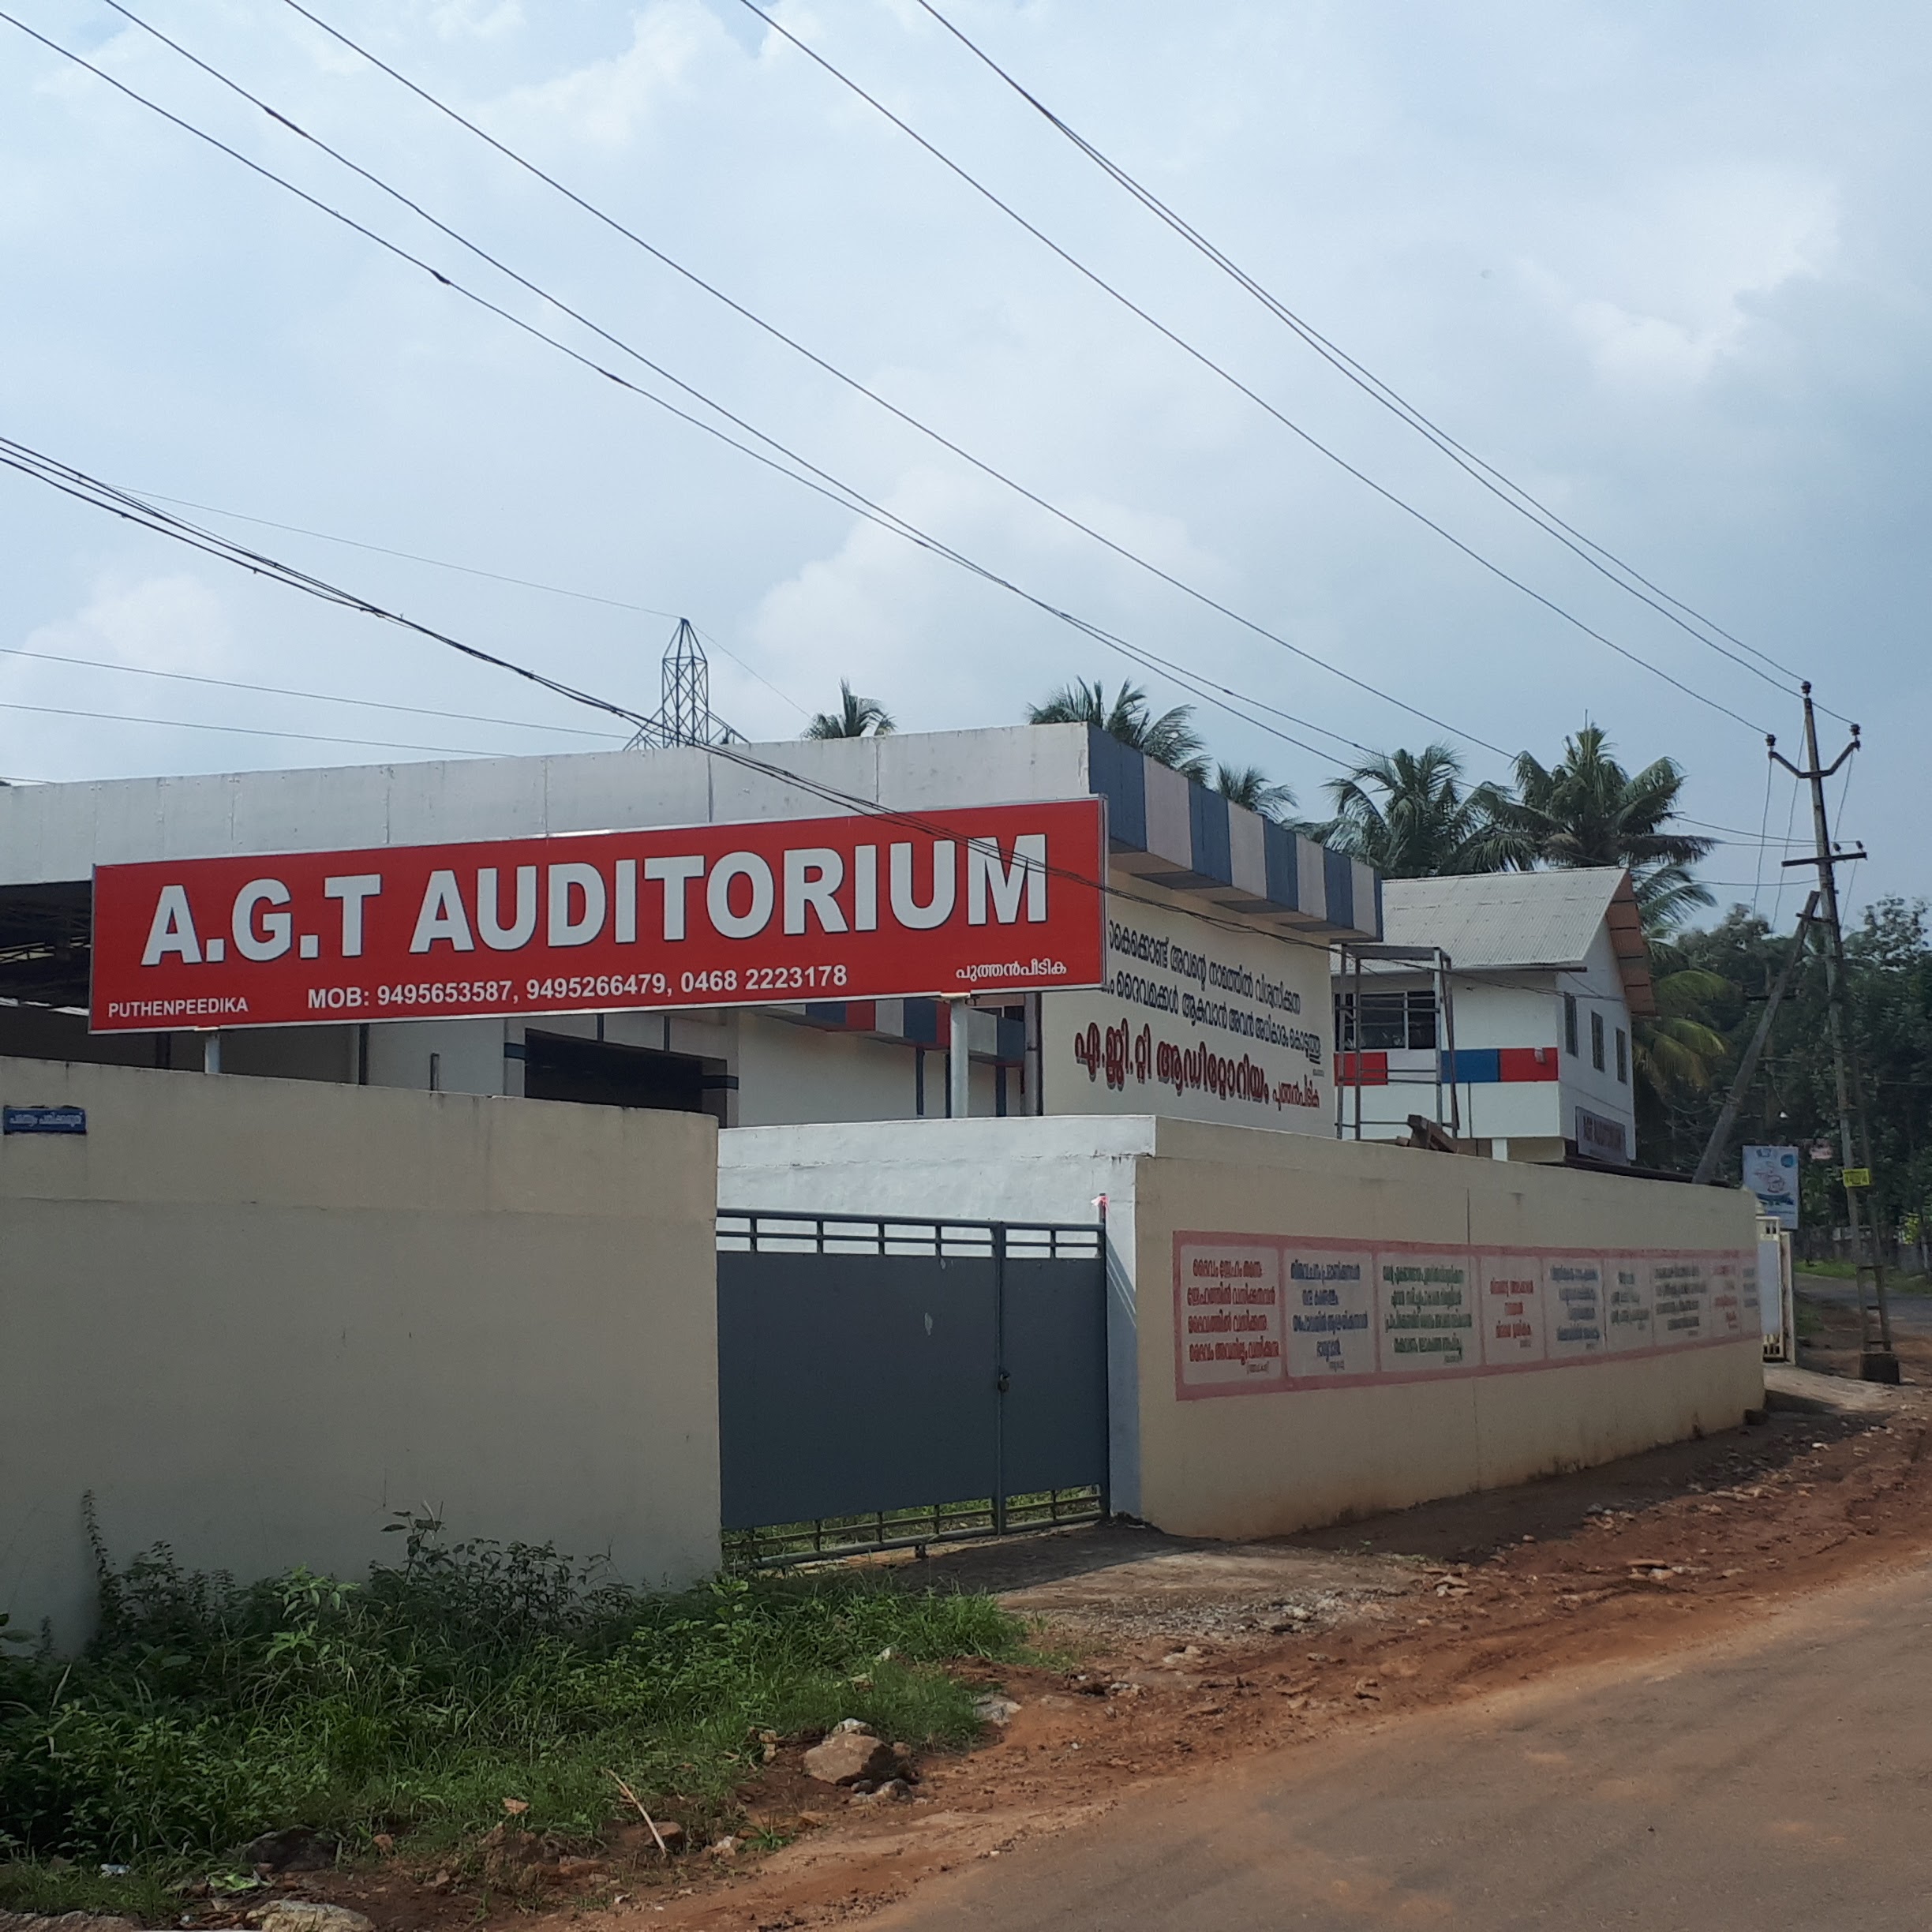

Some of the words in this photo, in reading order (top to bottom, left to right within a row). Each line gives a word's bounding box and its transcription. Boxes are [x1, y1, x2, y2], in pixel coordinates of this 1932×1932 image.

[140, 874, 382, 966] A.G.T
[409, 833, 1047, 954] AUDITORIUM
[955, 957, 1068, 981] പുത്തൻപീടിക
[307, 987, 370, 1009] MOB:
[376, 980, 519, 1006] 9495653587,
[526, 972, 673, 1000] 9495266479,
[680, 969, 738, 993] 0468
[745, 964, 848, 990] 2223178
[108, 997, 249, 1018] PUTHENPEEDIKA
